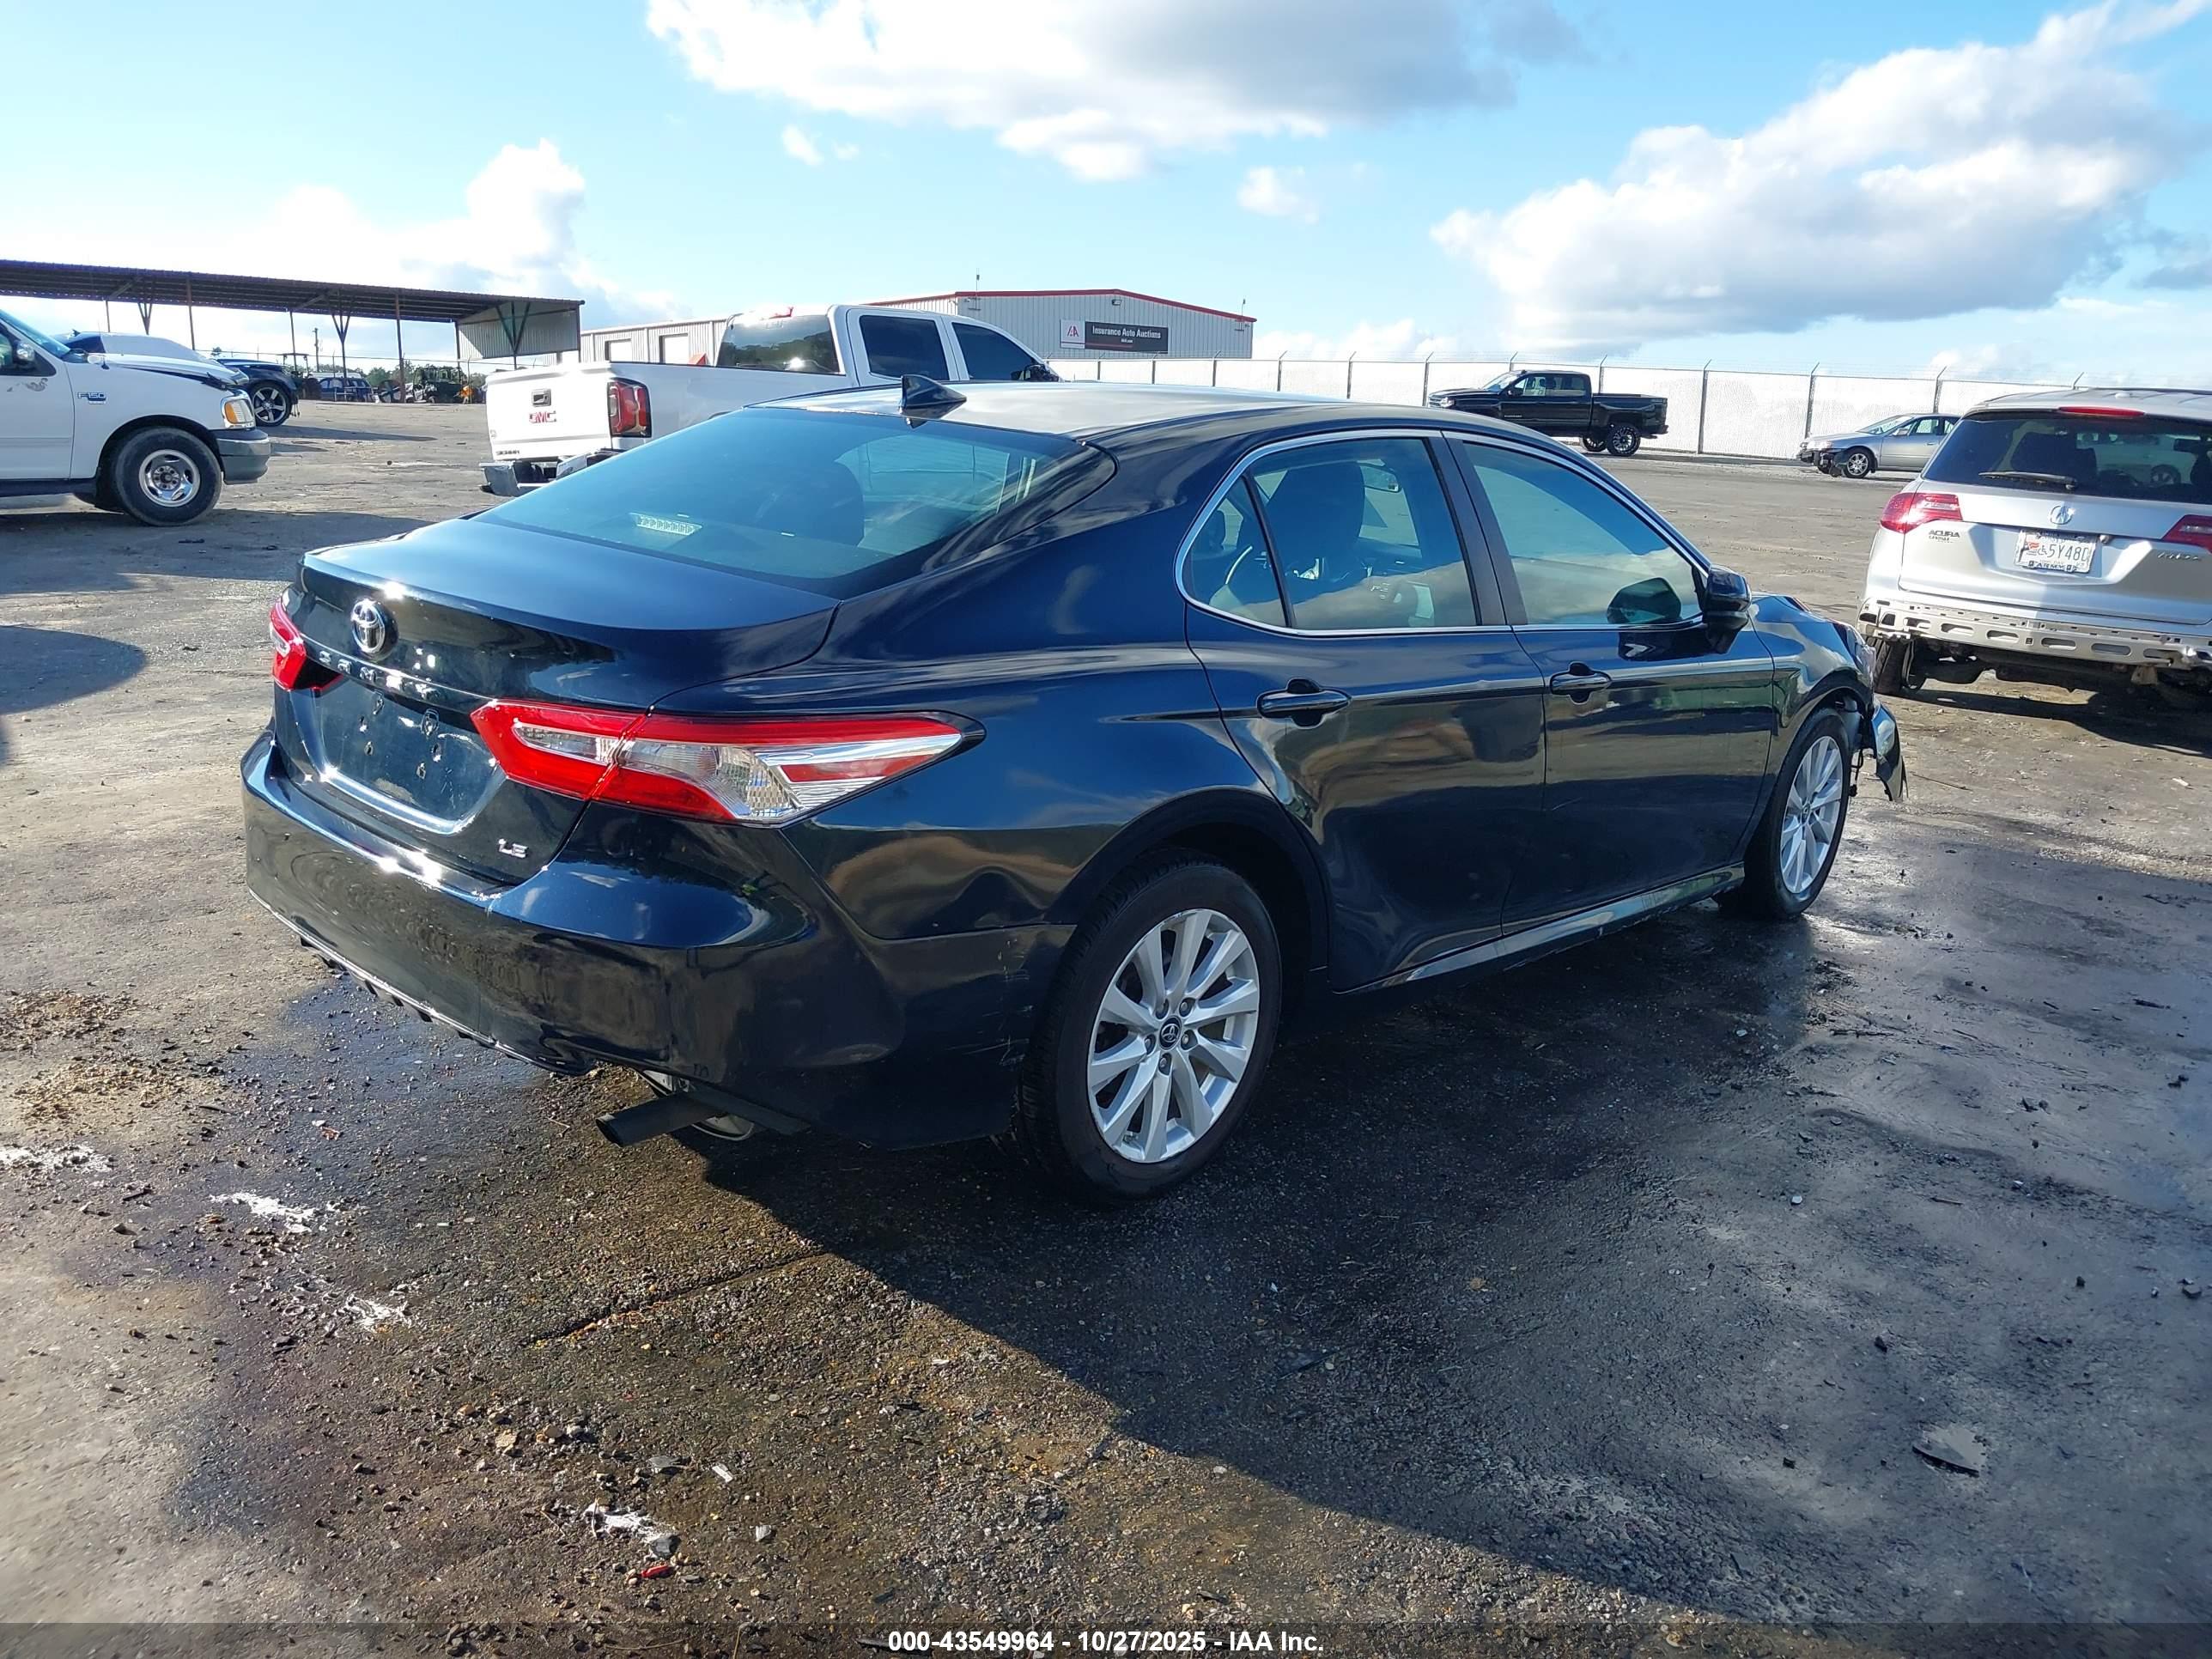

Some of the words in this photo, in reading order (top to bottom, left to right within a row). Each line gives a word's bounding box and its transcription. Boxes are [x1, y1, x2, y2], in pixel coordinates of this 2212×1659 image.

[1092, 325, 1121, 337] Insurance
[1122, 328, 1135, 337] Auto
[1136, 329, 1161, 338] Auctions
[528, 410, 556, 423] GMC
[1929, 529, 1960, 538] ACURA
[498, 838, 527, 859] LE
